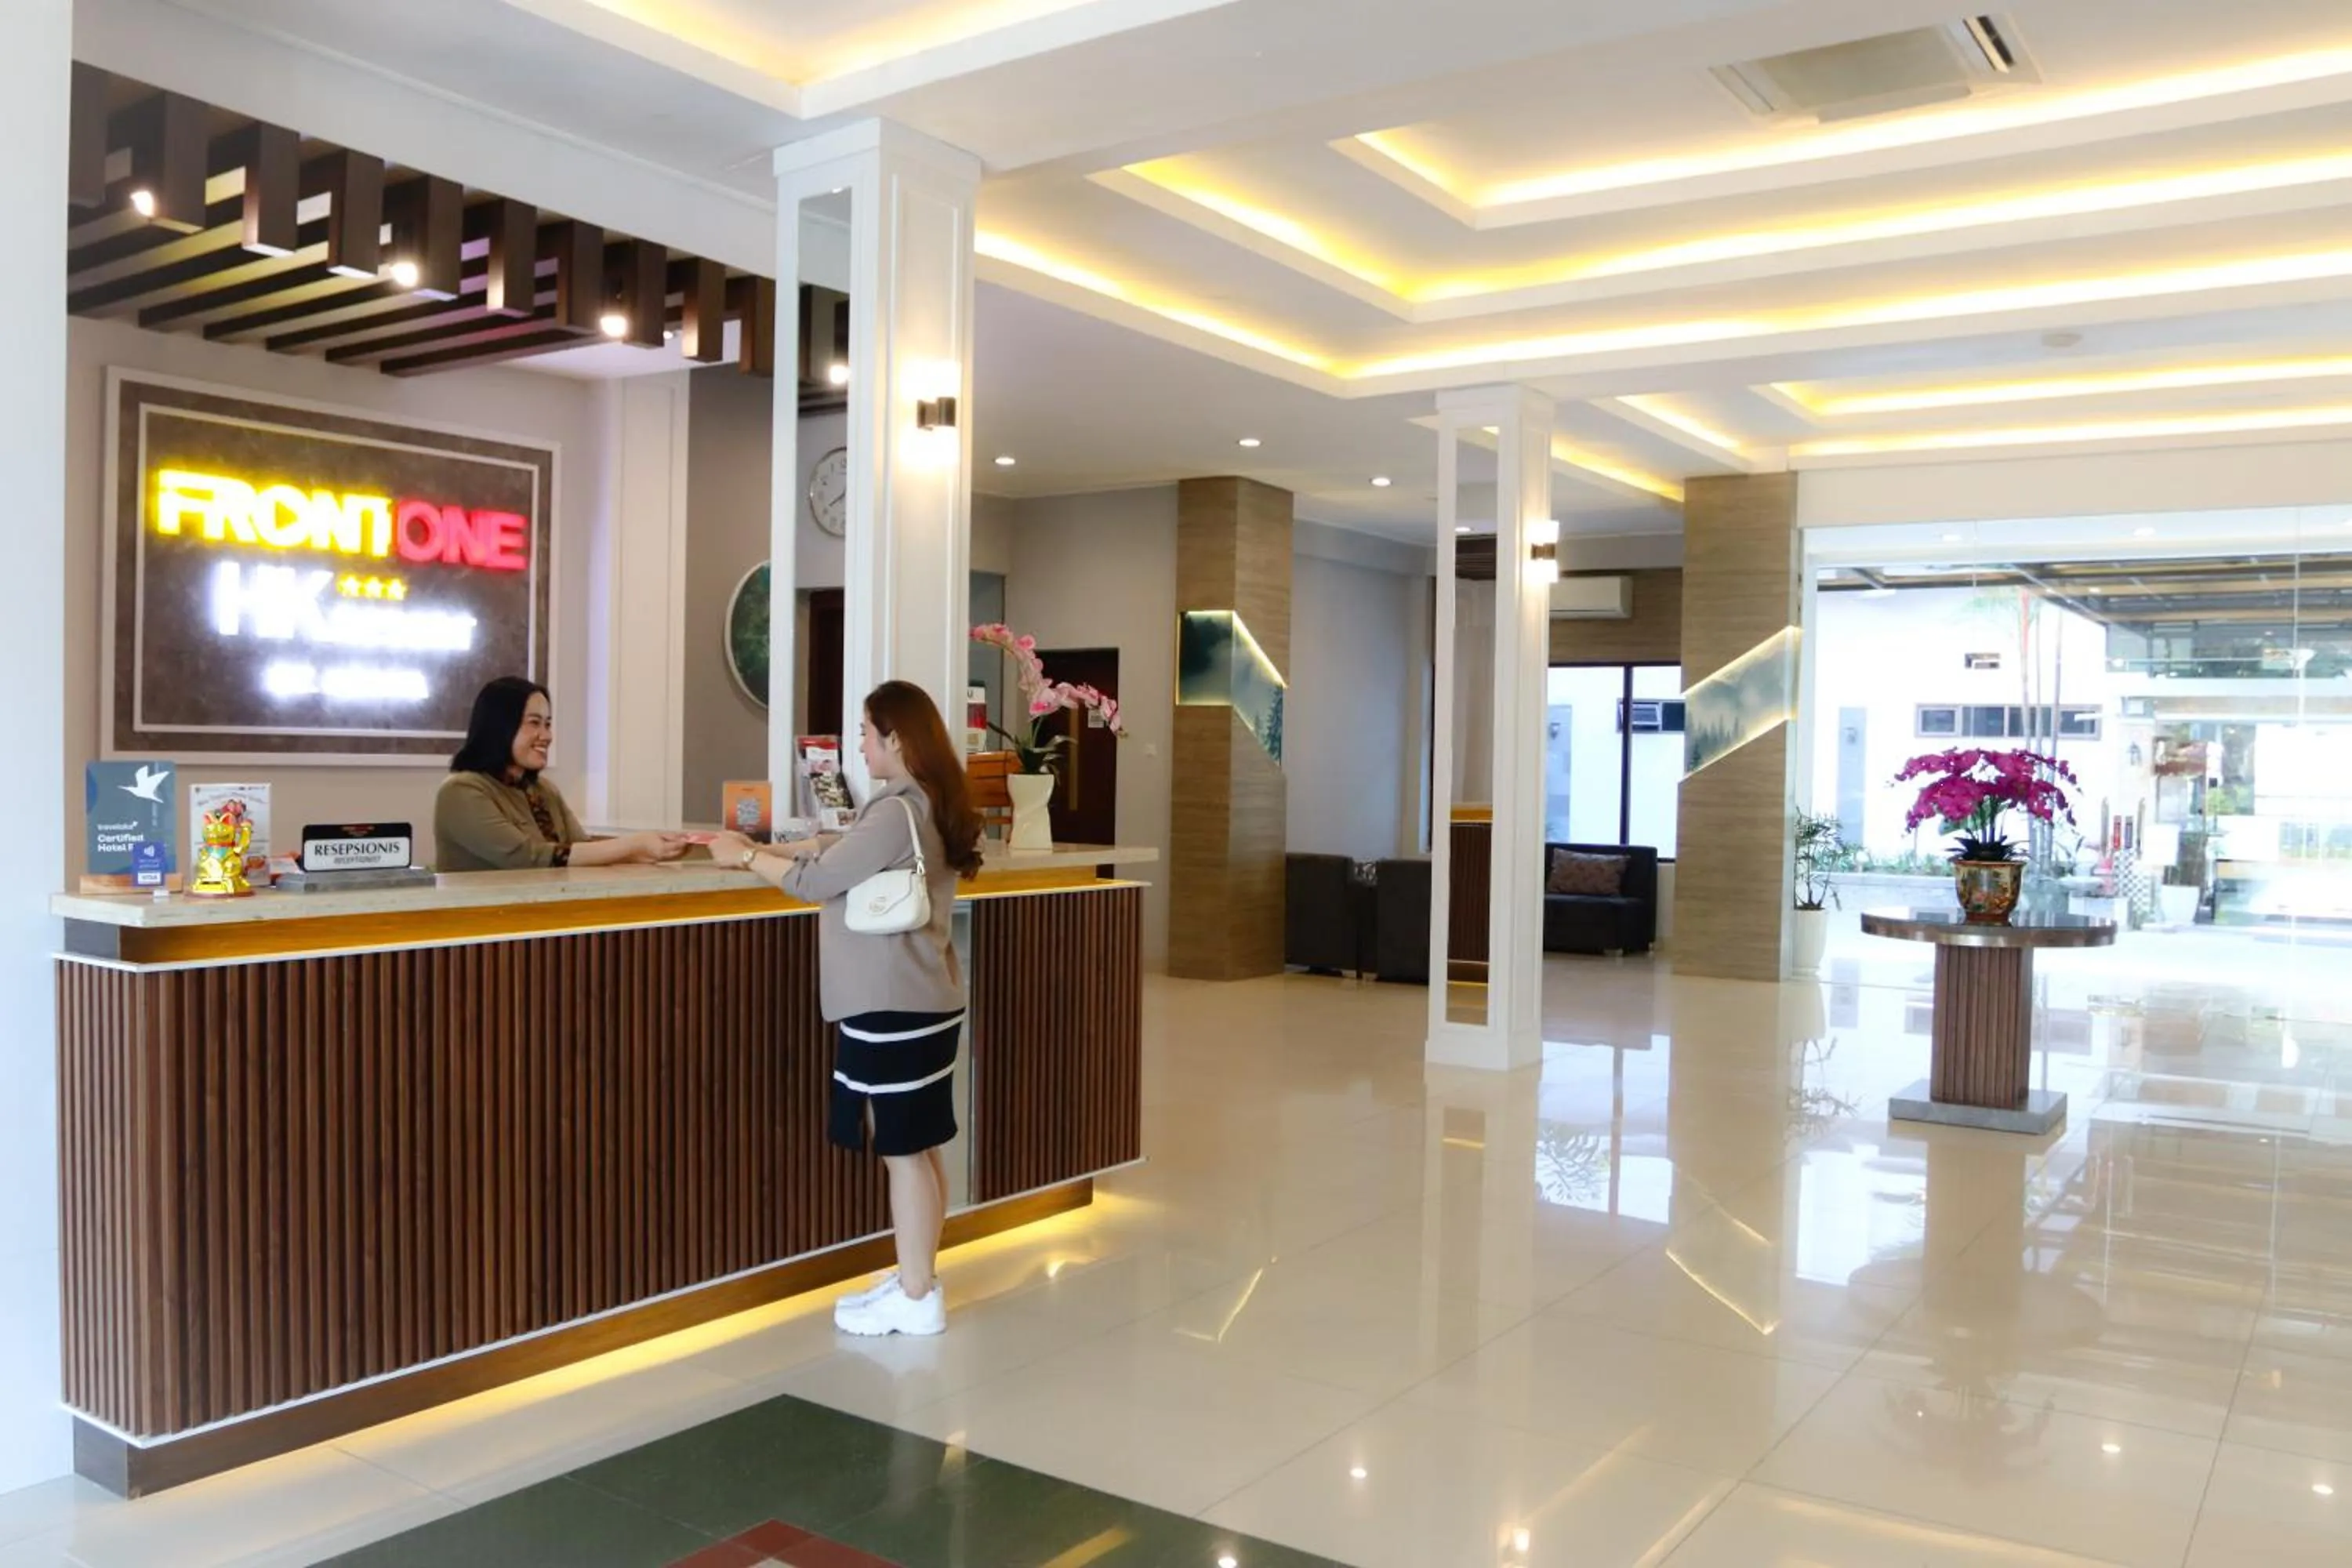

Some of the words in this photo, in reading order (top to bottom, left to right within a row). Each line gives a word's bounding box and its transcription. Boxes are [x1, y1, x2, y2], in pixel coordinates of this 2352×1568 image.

[97, 833, 143, 843] Certified
[97, 844, 127, 852] Hotel
[314, 841, 401, 856] RESEPSIONIS
